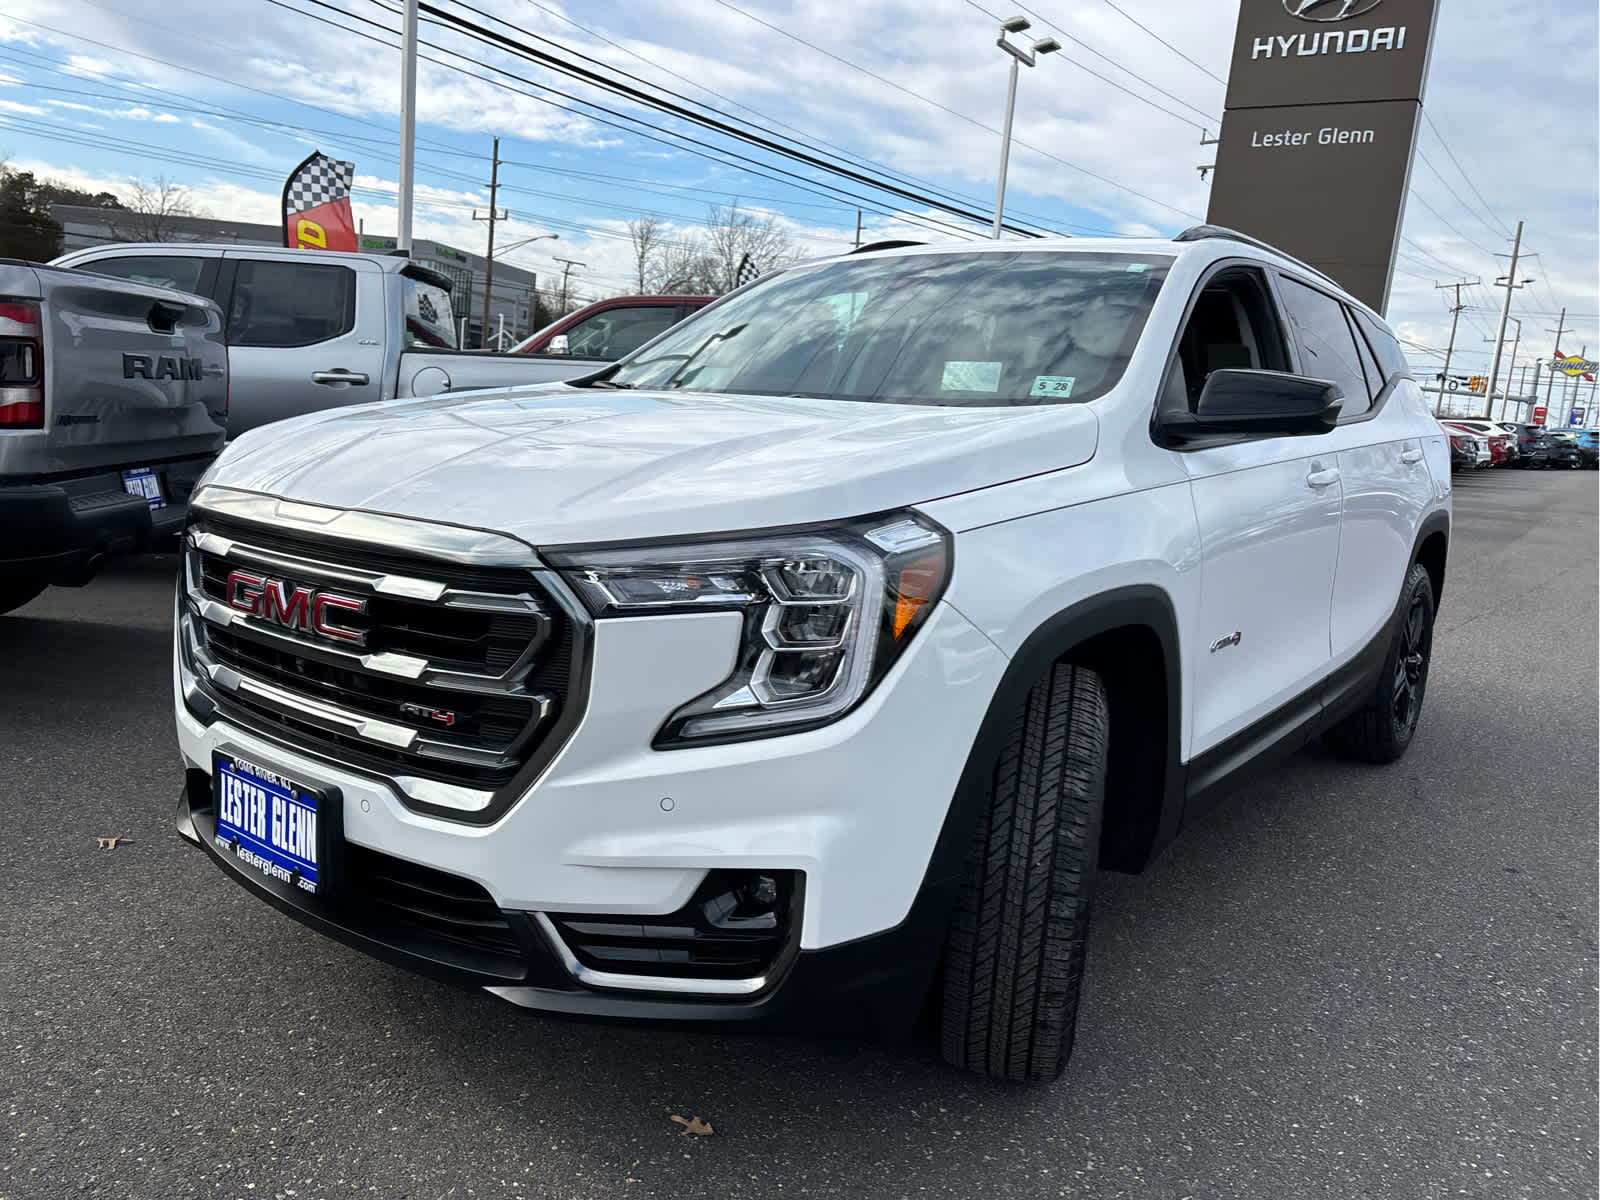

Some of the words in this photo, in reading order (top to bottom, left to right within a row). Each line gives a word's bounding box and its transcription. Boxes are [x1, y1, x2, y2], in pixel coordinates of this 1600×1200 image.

[1252, 27, 1406, 60] HYUNDAI
[1251, 130, 1311, 148] Lester
[1318, 127, 1375, 145] Glenn
[122, 352, 203, 381] RAM
[1551, 361, 1598, 371] SUNOCO
[1038, 381, 1047, 391] 5
[1053, 382, 1069, 391] 28
[226, 569, 369, 647] GMC
[220, 773, 266, 841] LESTER
[272, 797, 317, 864] GLENN
[236, 845, 291, 883] lesterglenn
[297, 878, 316, 894] .com
